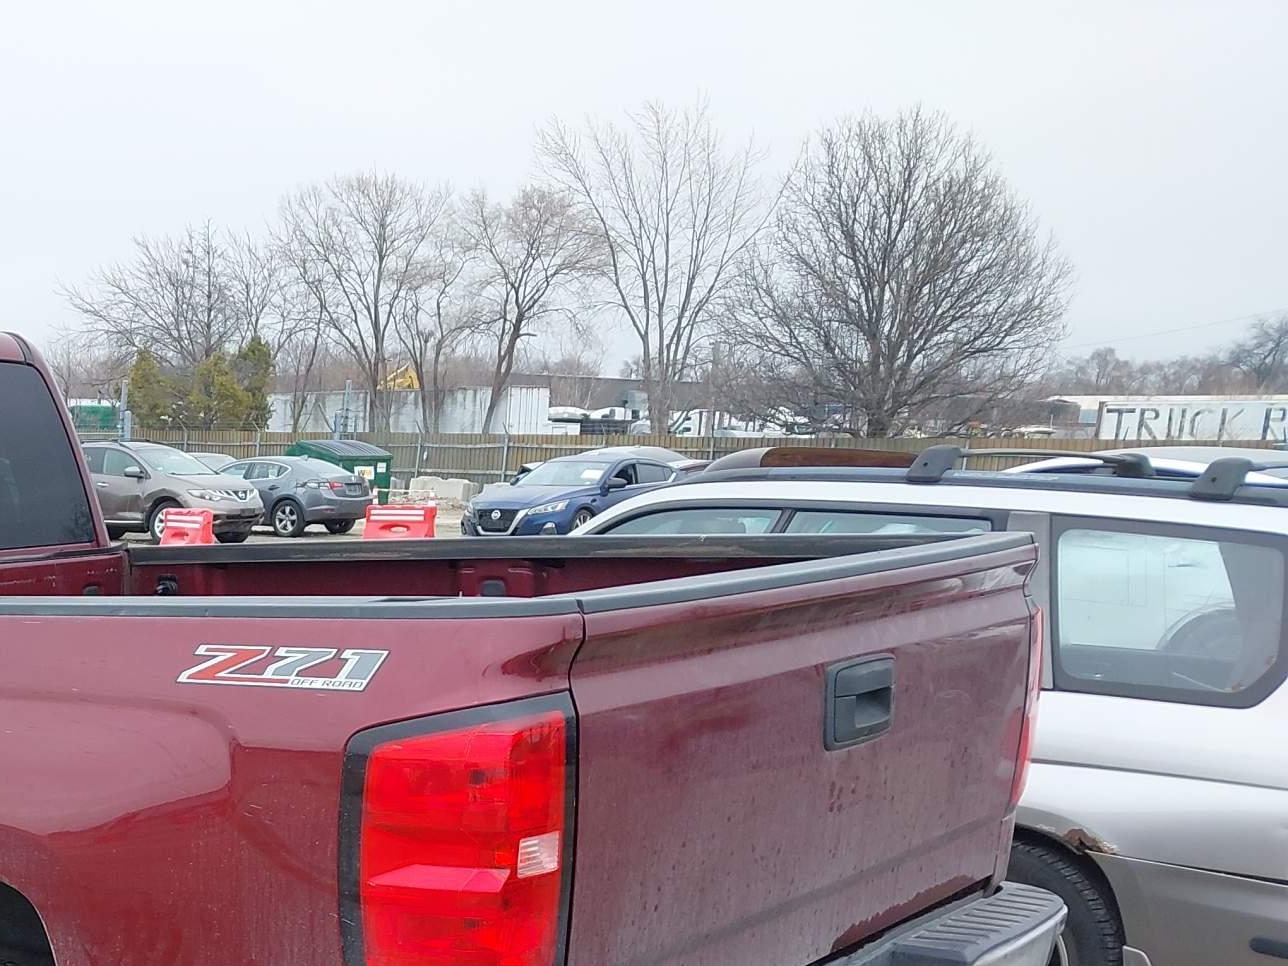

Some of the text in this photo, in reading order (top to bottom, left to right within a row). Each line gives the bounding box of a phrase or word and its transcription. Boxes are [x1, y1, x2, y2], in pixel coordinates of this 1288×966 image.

[1105, 406, 1245, 441] TRUCK
[176, 644, 390, 690] Z71
[291, 678, 364, 690] OFF ROAD
